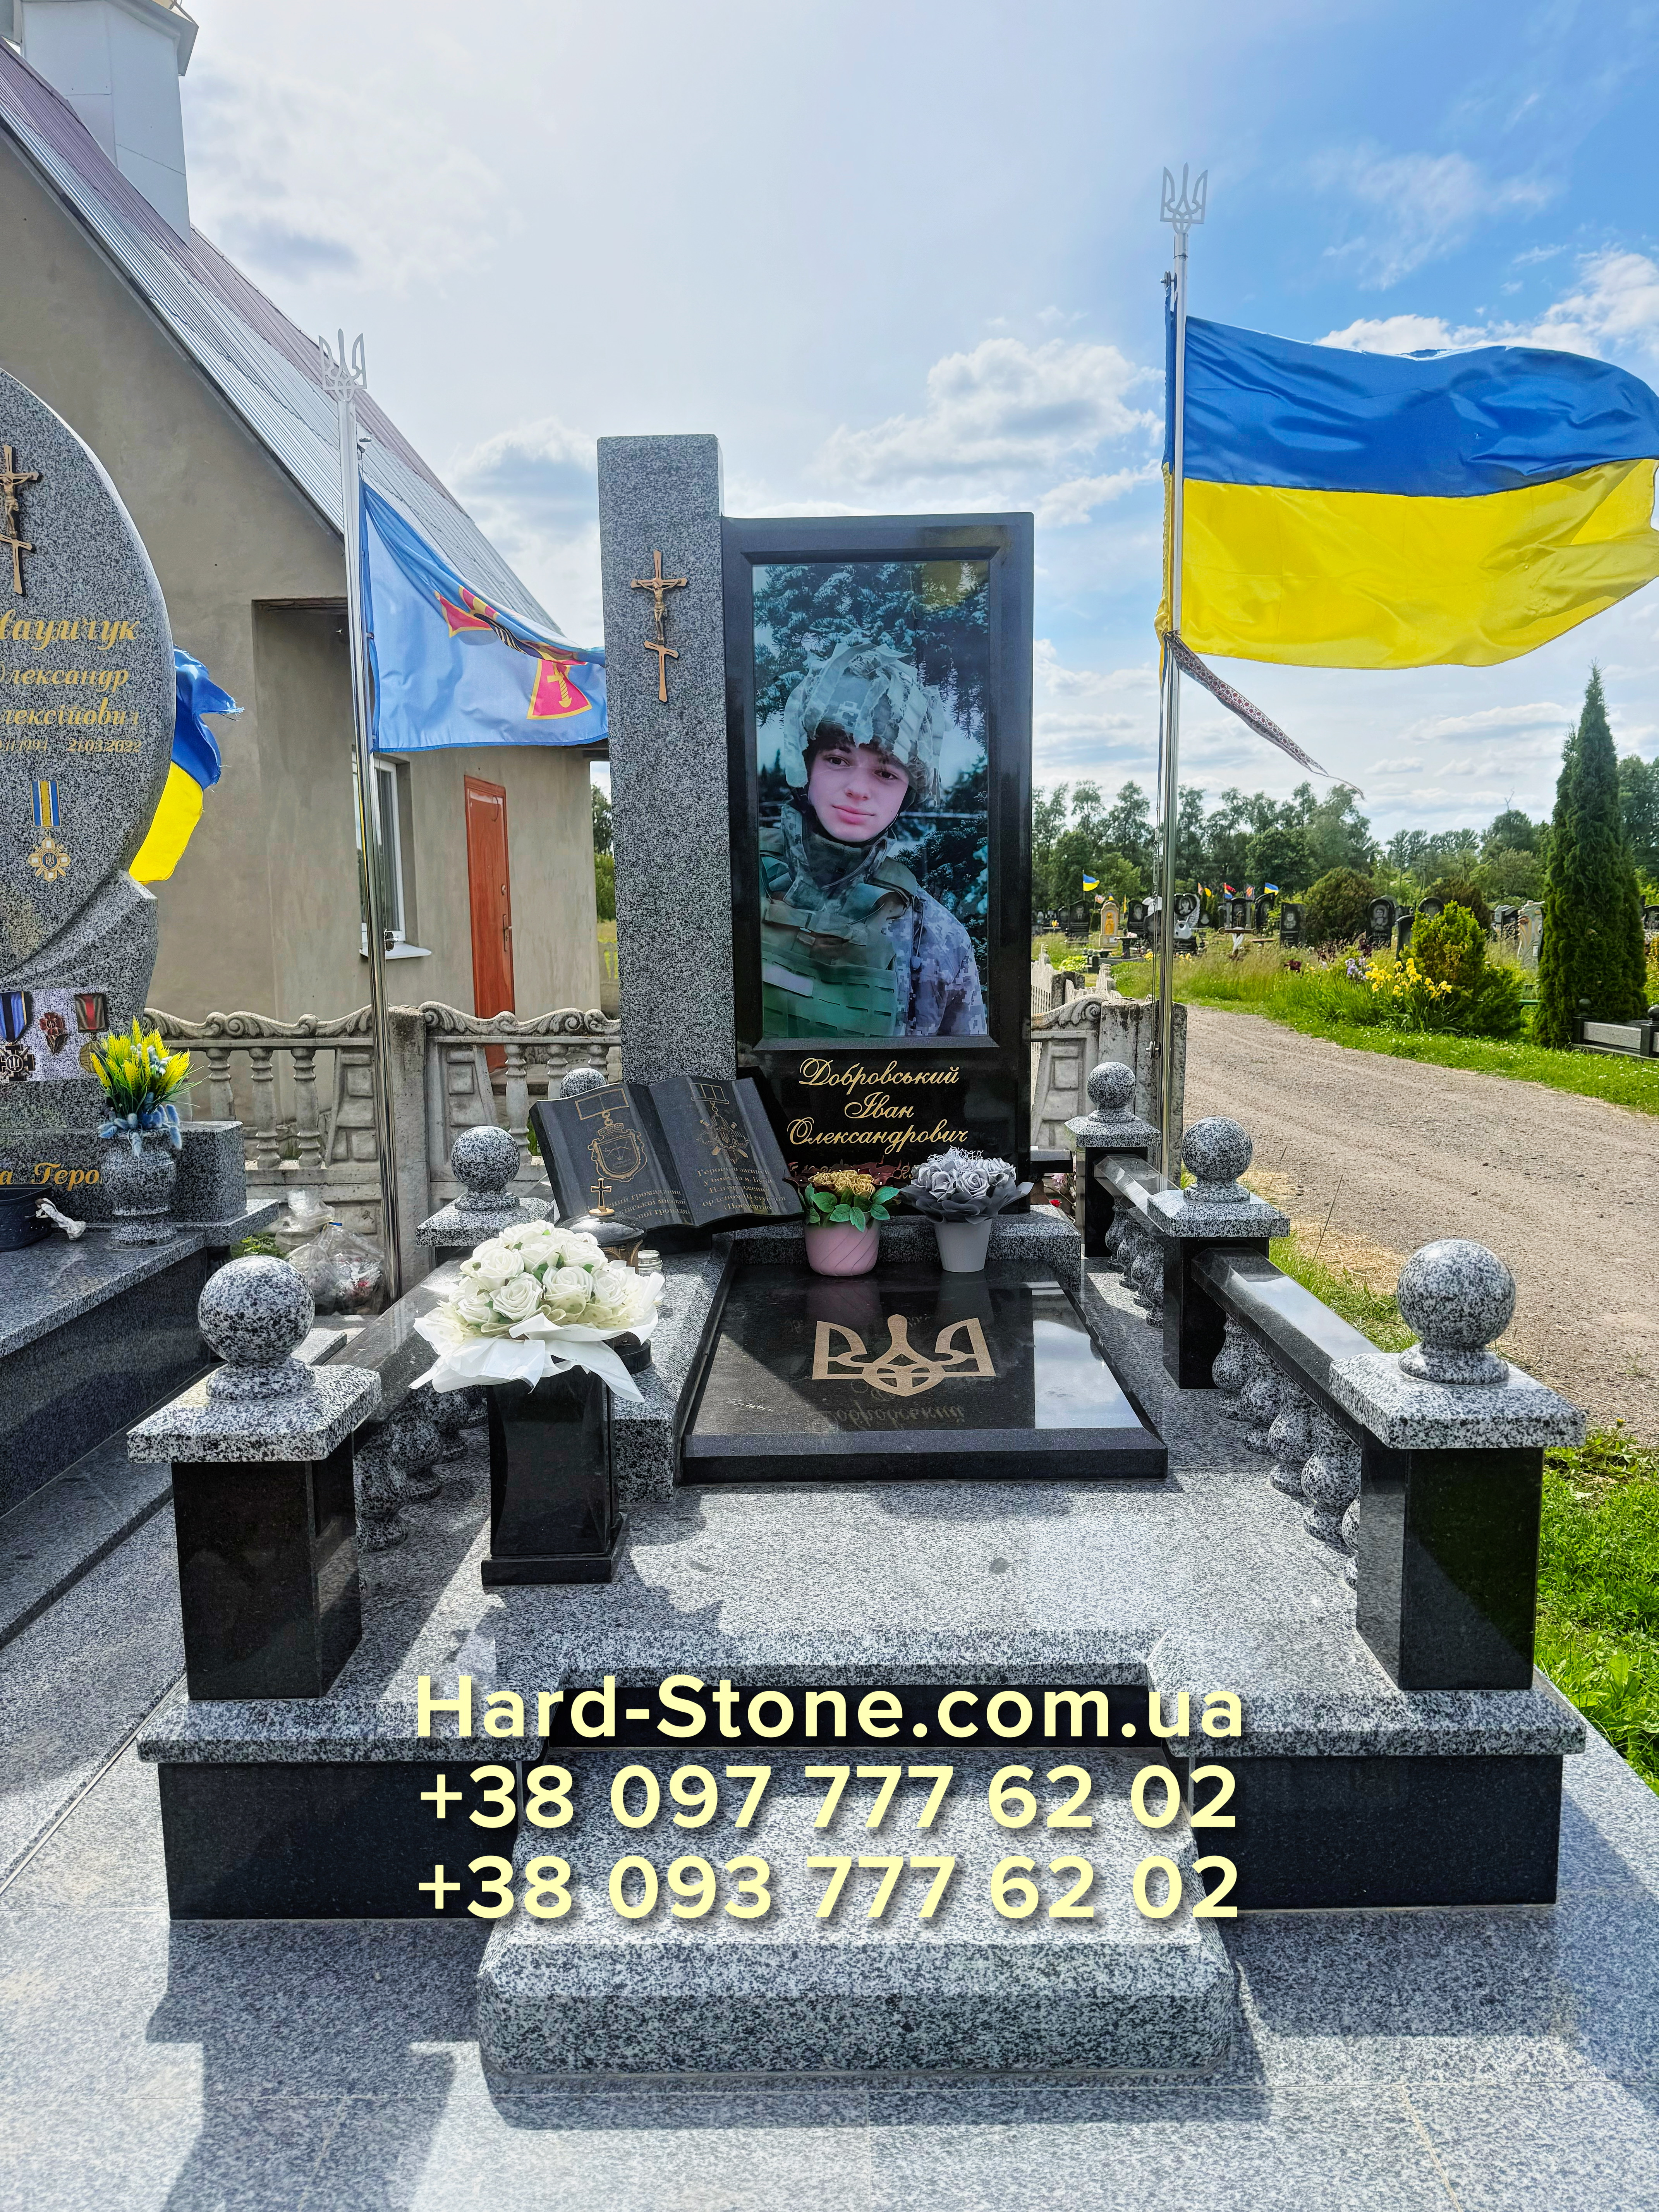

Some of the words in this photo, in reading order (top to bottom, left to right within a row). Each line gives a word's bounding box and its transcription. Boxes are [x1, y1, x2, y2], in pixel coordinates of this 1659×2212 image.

[0, 697, 139, 726] лексійович
[799, 1058, 960, 1095] Добровський
[844, 1091, 914, 1119] Іван
[787, 1117, 968, 1154] Олександрович
[31, 1162, 103, 1191] Геро
